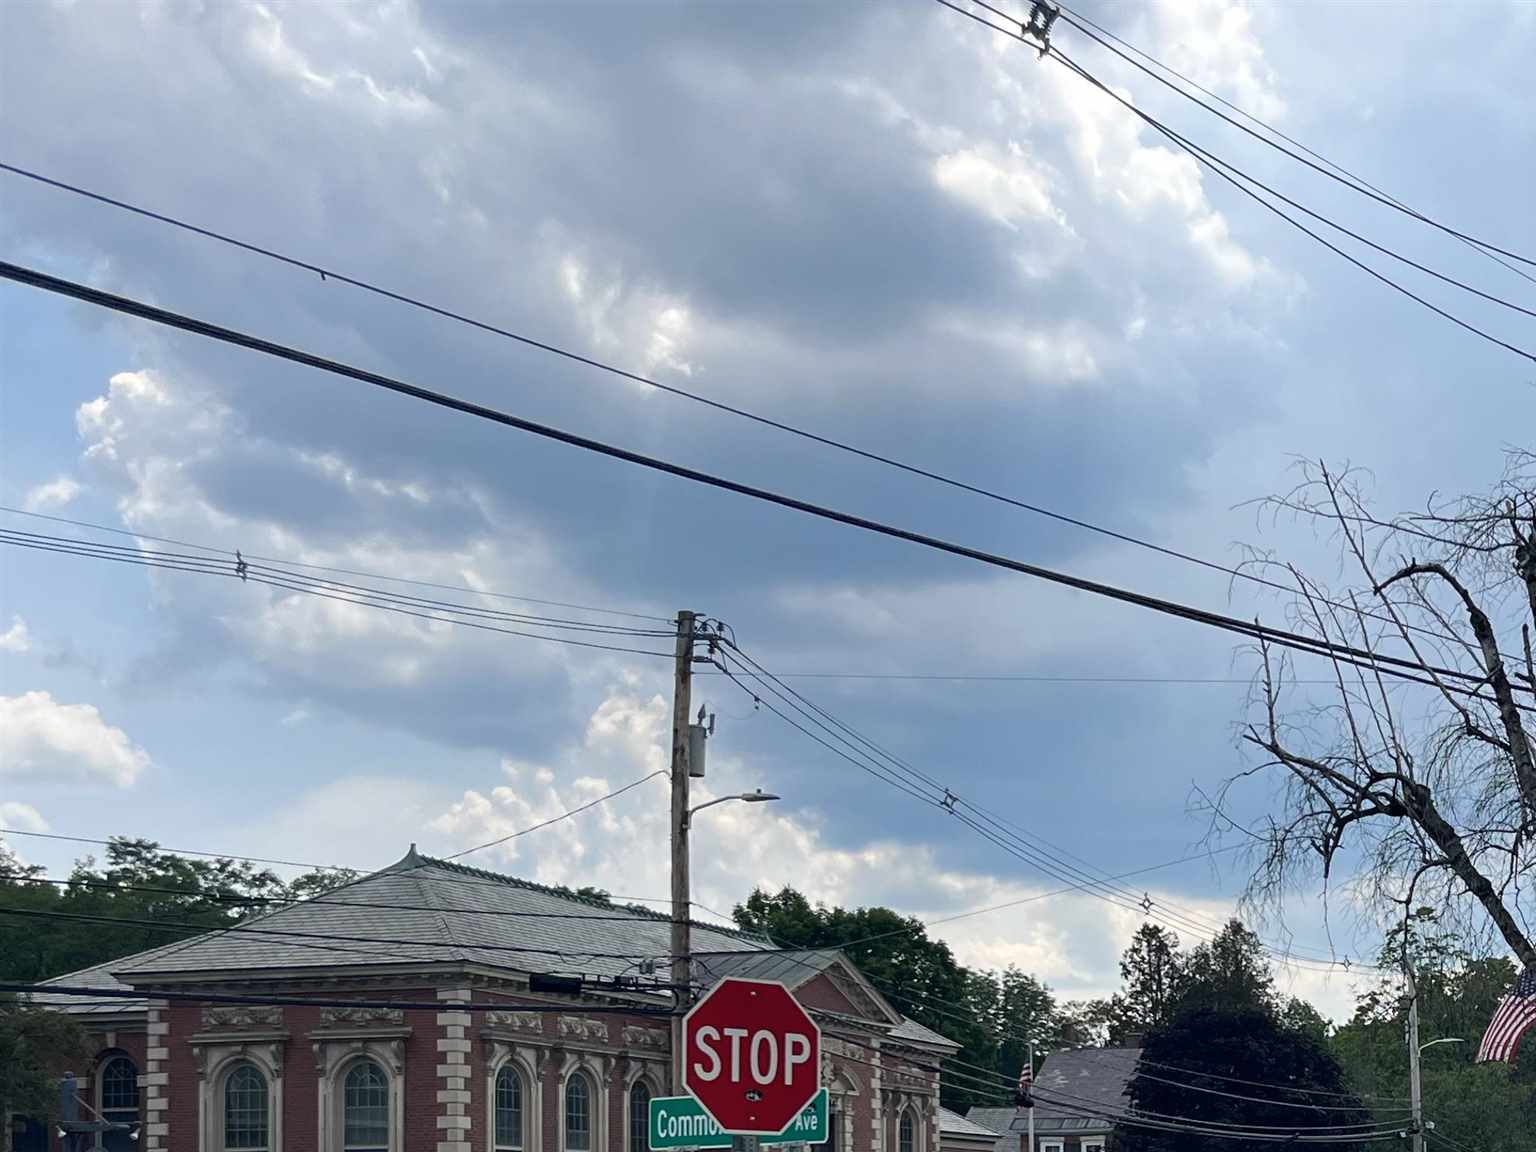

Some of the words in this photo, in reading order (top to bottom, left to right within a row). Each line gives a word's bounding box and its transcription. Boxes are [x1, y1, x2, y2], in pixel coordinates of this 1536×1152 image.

[693, 1025, 811, 1086] STOP
[657, 1109, 722, 1138] Commo
[795, 1113, 818, 1131] Ave
